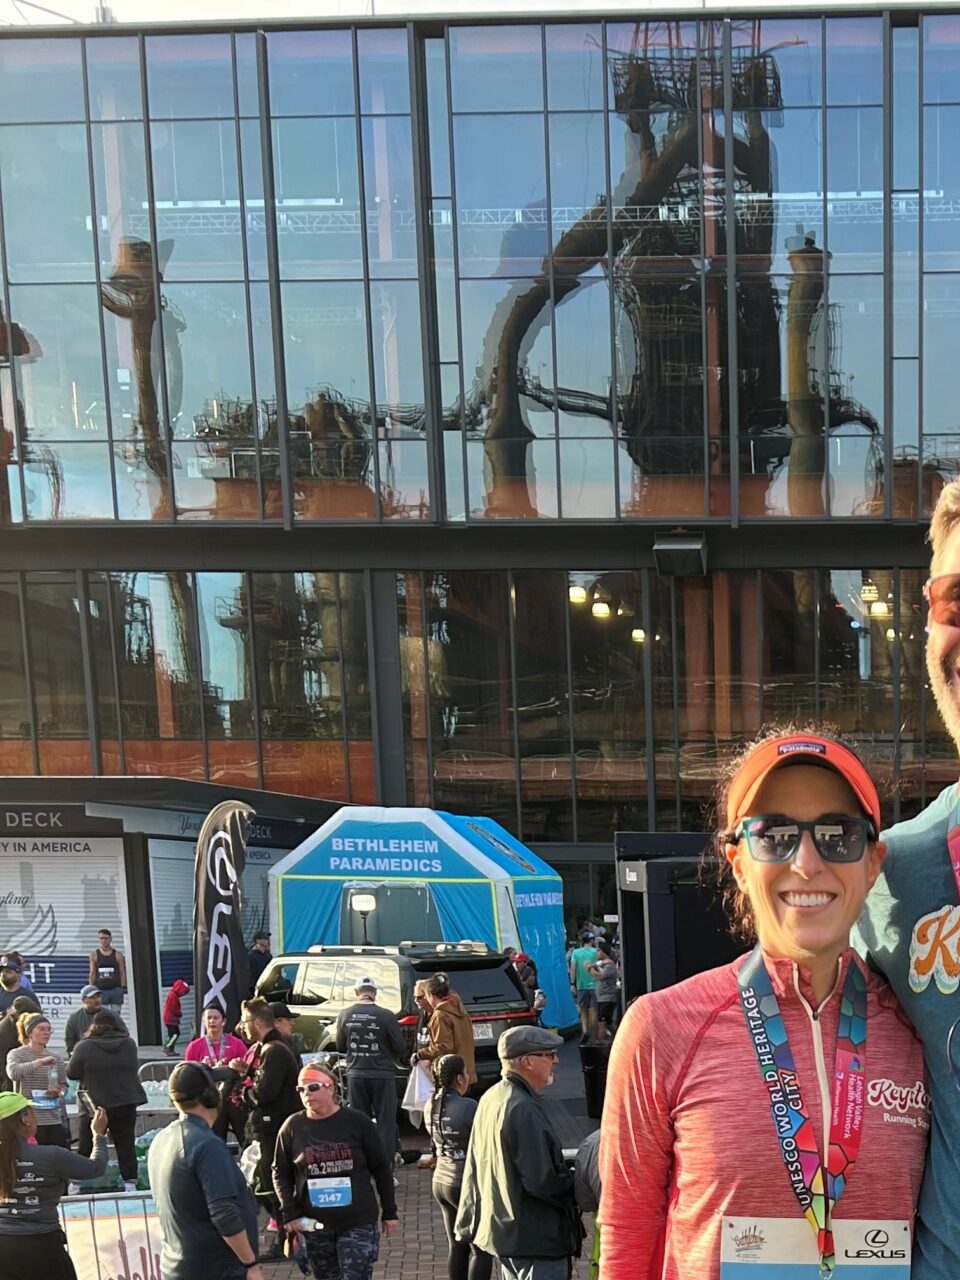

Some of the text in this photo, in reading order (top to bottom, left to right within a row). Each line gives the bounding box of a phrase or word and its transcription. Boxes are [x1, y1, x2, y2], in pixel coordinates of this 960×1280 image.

[6, 812, 63, 827] DECK
[13, 842, 27, 852] IN
[31, 842, 92, 853] AMERICA
[331, 837, 439, 853] BETHLEHEM
[329, 857, 442, 872] PARAMEDICS
[741, 987, 811, 1206] UNESCO WORLD HERITAGE
[781, 1072, 804, 1111] CITY
[843, 1073, 857, 1140] Health Network
[852, 1075, 865, 1131] Lehigh Valley
[883, 1113, 917, 1128] Running
[318, 1193, 342, 1203] 2147
[844, 1250, 905, 1258] LEXUS
